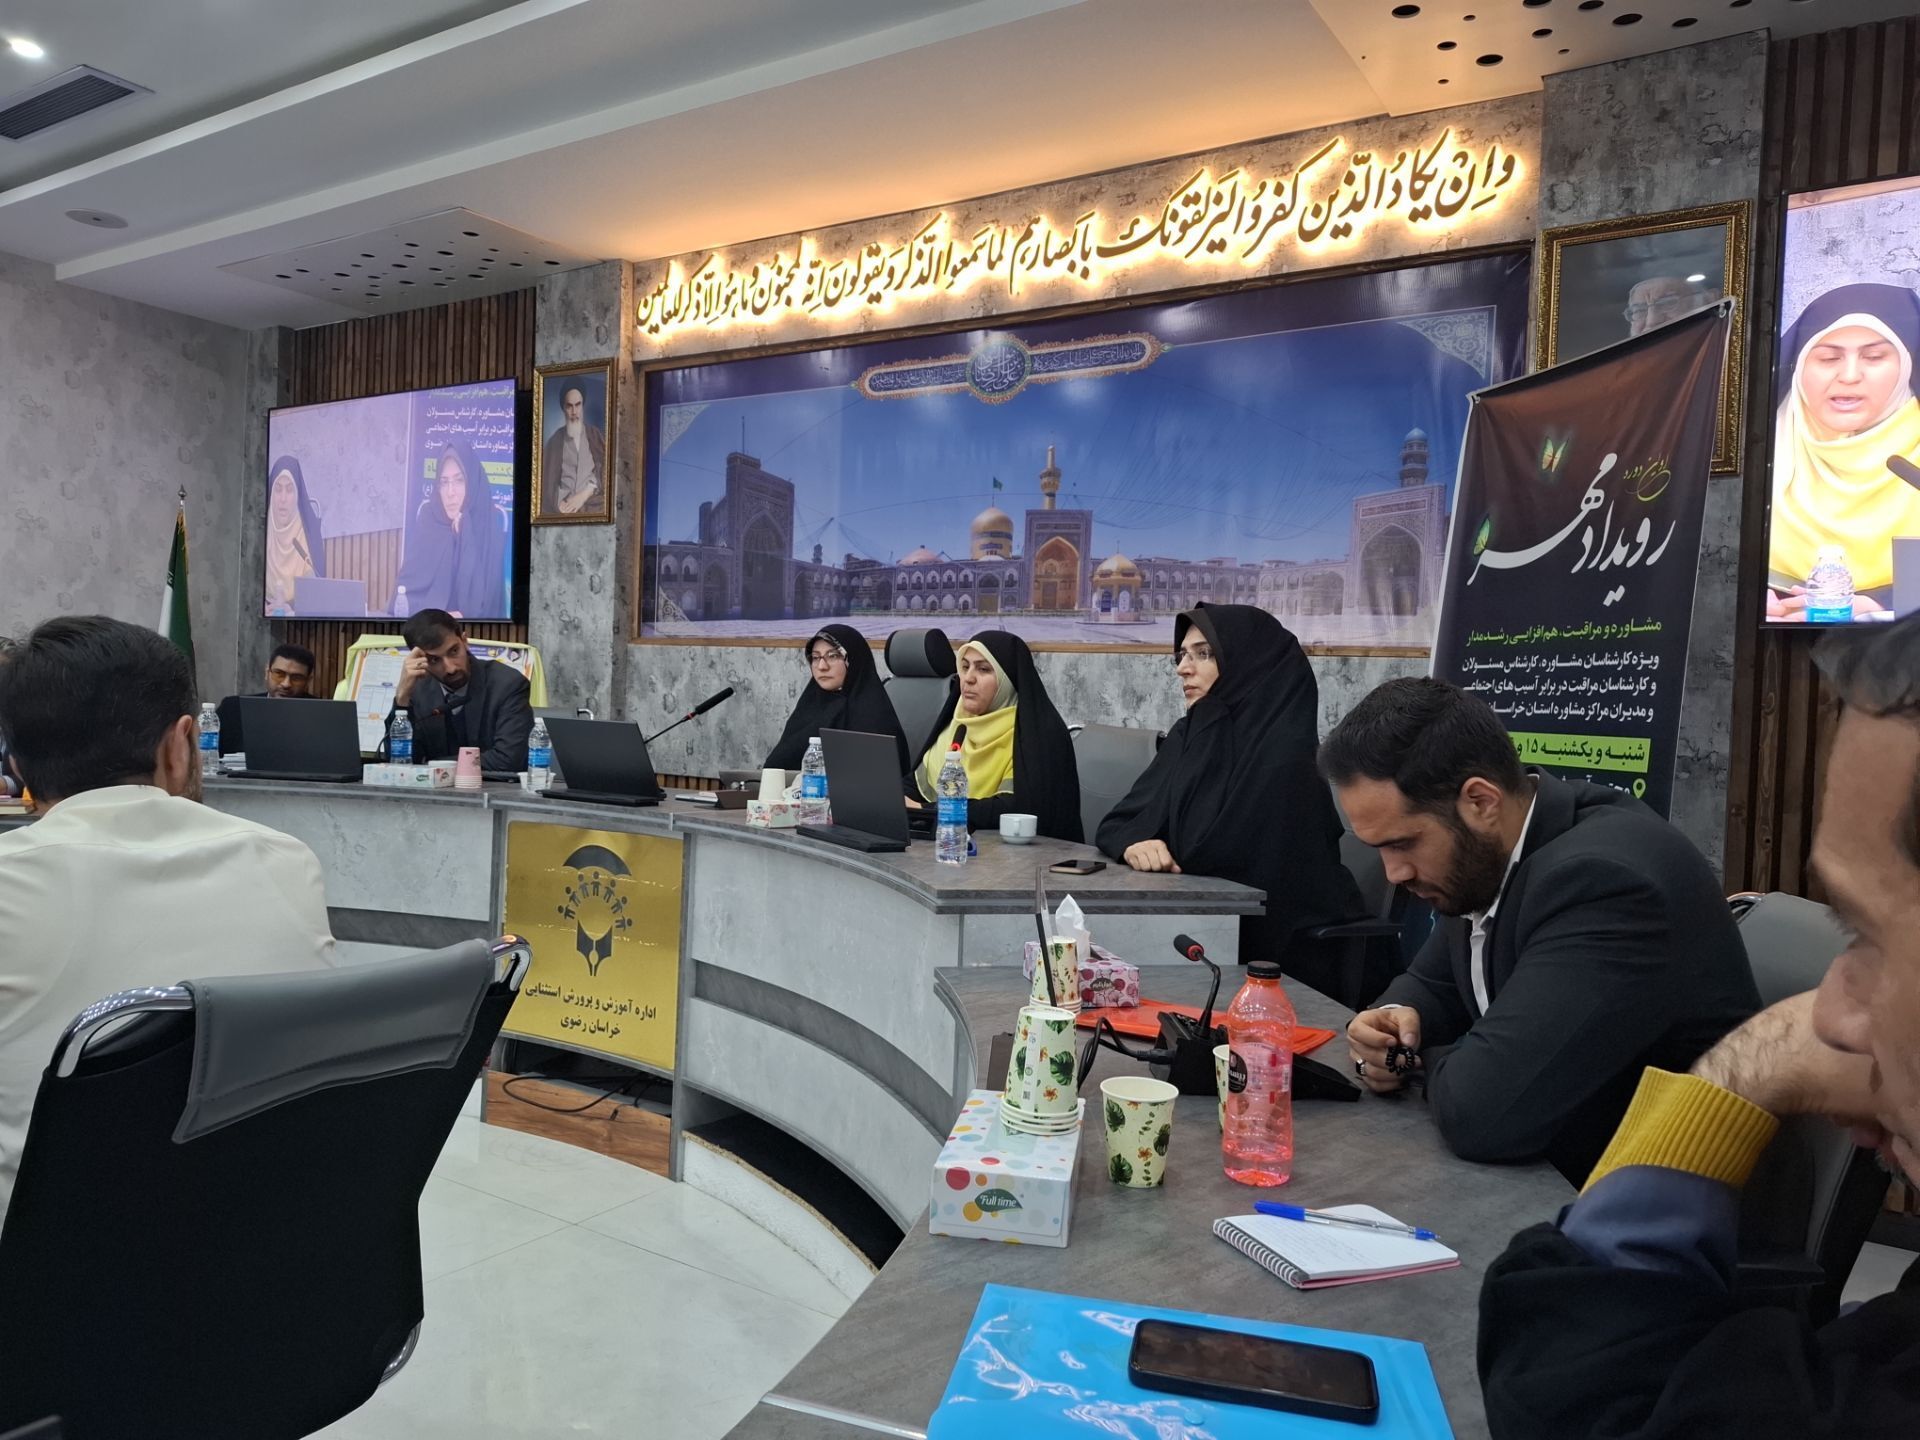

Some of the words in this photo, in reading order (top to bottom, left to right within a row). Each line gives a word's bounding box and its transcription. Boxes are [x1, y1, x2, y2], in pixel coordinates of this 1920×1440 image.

[1466, 452, 1618, 586] مهر
[1603, 624, 1610, 640] و
[1610, 616, 1662, 639] مشاوره
[1503, 654, 1540, 673] کارشناس
[1583, 650, 1633, 671] کارشناسان
[1631, 651, 1660, 671] ویژه
[1462, 678, 1496, 694] اجتماع
[1538, 678, 1557, 696] برابر
[1556, 680, 1568, 696] در
[1568, 677, 1599, 697] مراقبت
[1599, 676, 1650, 697] کارشناسان
[1648, 681, 1657, 697] و
[1524, 700, 1555, 717] استان
[1553, 701, 1586, 720] مشاوره
[1584, 702, 1610, 721] مراکز
[1609, 702, 1647, 722] مدیران
[1645, 706, 1654, 723] و
[1540, 740, 1594, 762] یکشنبه
[1593, 747, 1603, 765] و
[1604, 743, 1645, 766] شنبه
[562, 988, 593, 1009] پرورش
[601, 996, 633, 1016] آموزش
[634, 1003, 657, 1021] اداره
[560, 1014, 587, 1033] رضوی
[588, 1018, 621, 1039] خراسان
